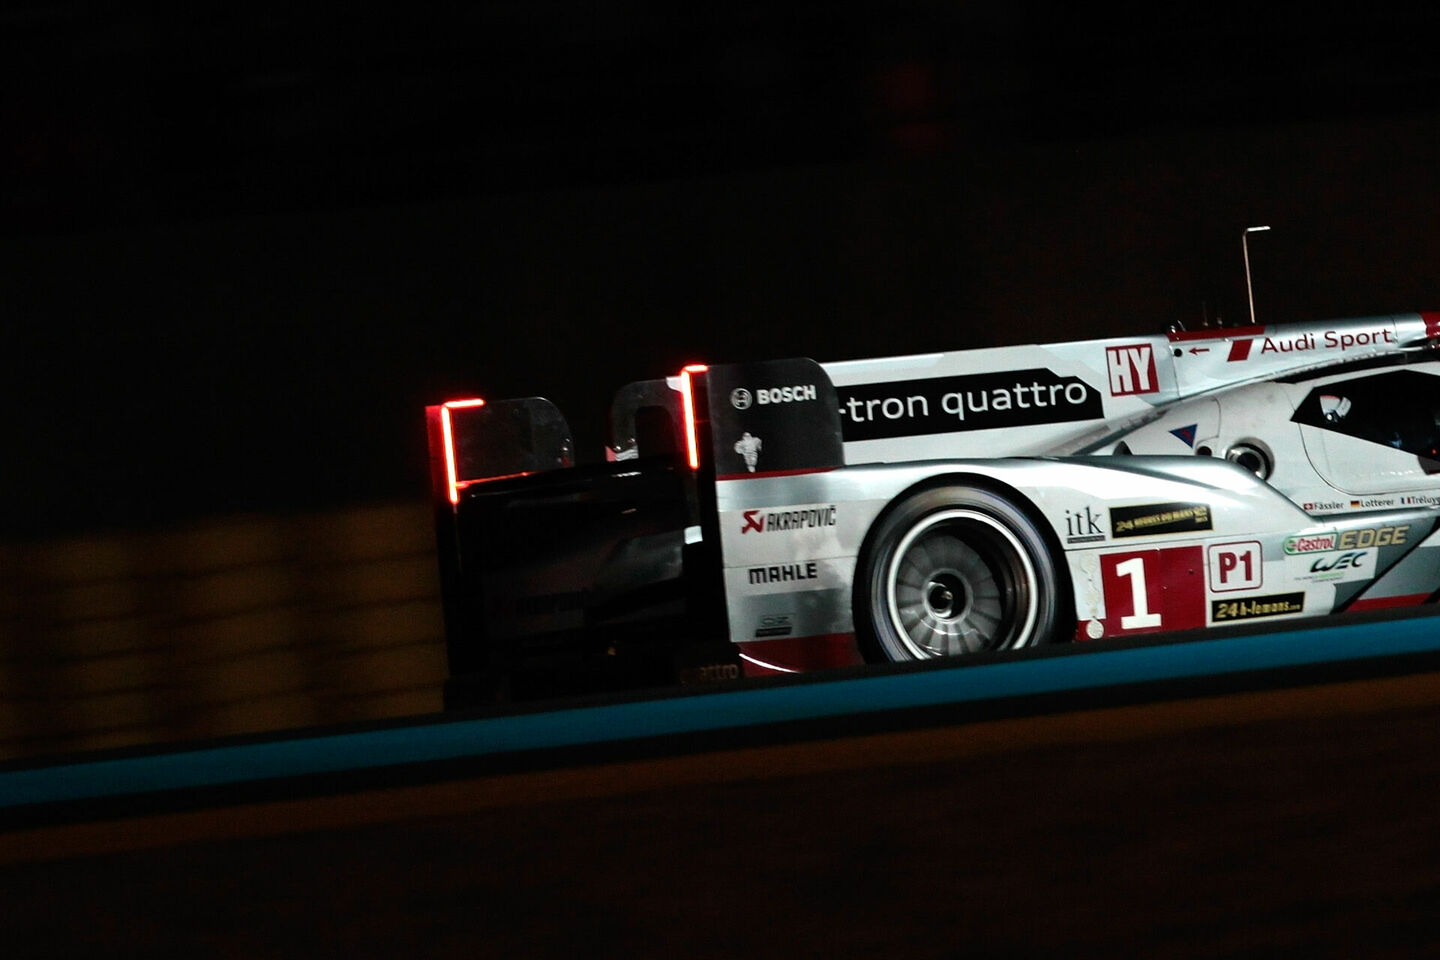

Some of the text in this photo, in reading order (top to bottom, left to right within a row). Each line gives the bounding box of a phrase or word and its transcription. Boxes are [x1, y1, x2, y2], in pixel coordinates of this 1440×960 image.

[1260, 328, 1393, 355] Audi Sport
[1108, 347, 1151, 394] HY
[756, 384, 817, 405] BOSCH
[941, 381, 1087, 421] quattro
[1065, 506, 1104, 536] itk
[1297, 525, 1410, 553] Castrol EDGE
[749, 562, 818, 585] MAHLE
[1218, 550, 1253, 584] P1
[1310, 551, 1368, 573] WEC
[1116, 557, 1162, 630] 1
